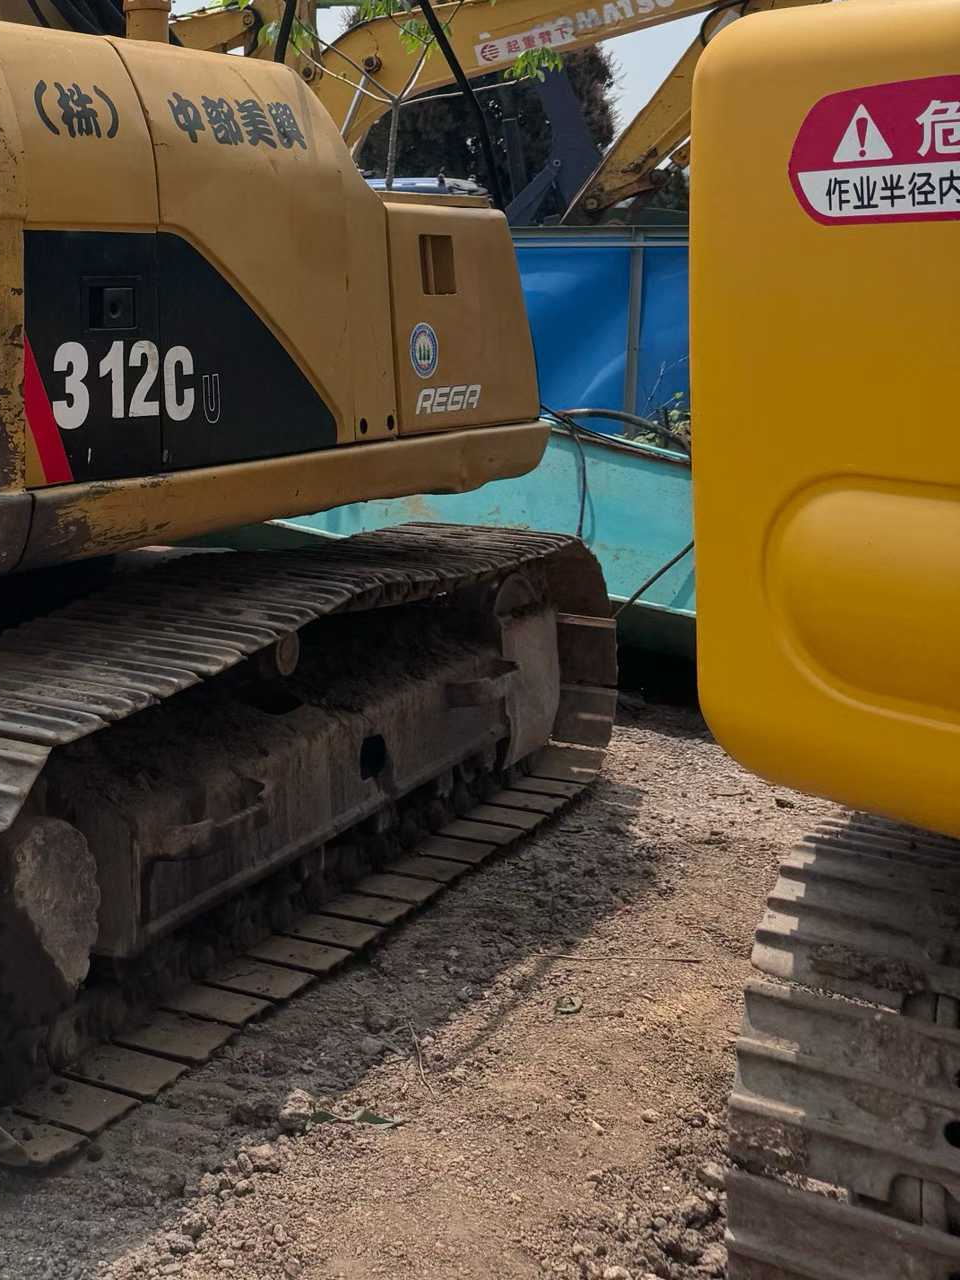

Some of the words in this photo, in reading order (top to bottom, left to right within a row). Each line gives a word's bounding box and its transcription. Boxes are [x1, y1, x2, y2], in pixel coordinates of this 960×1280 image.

[915, 99, 960, 157] 危
[825, 169, 960, 212] 作业半径内
[415, 384, 482, 415] REGA
